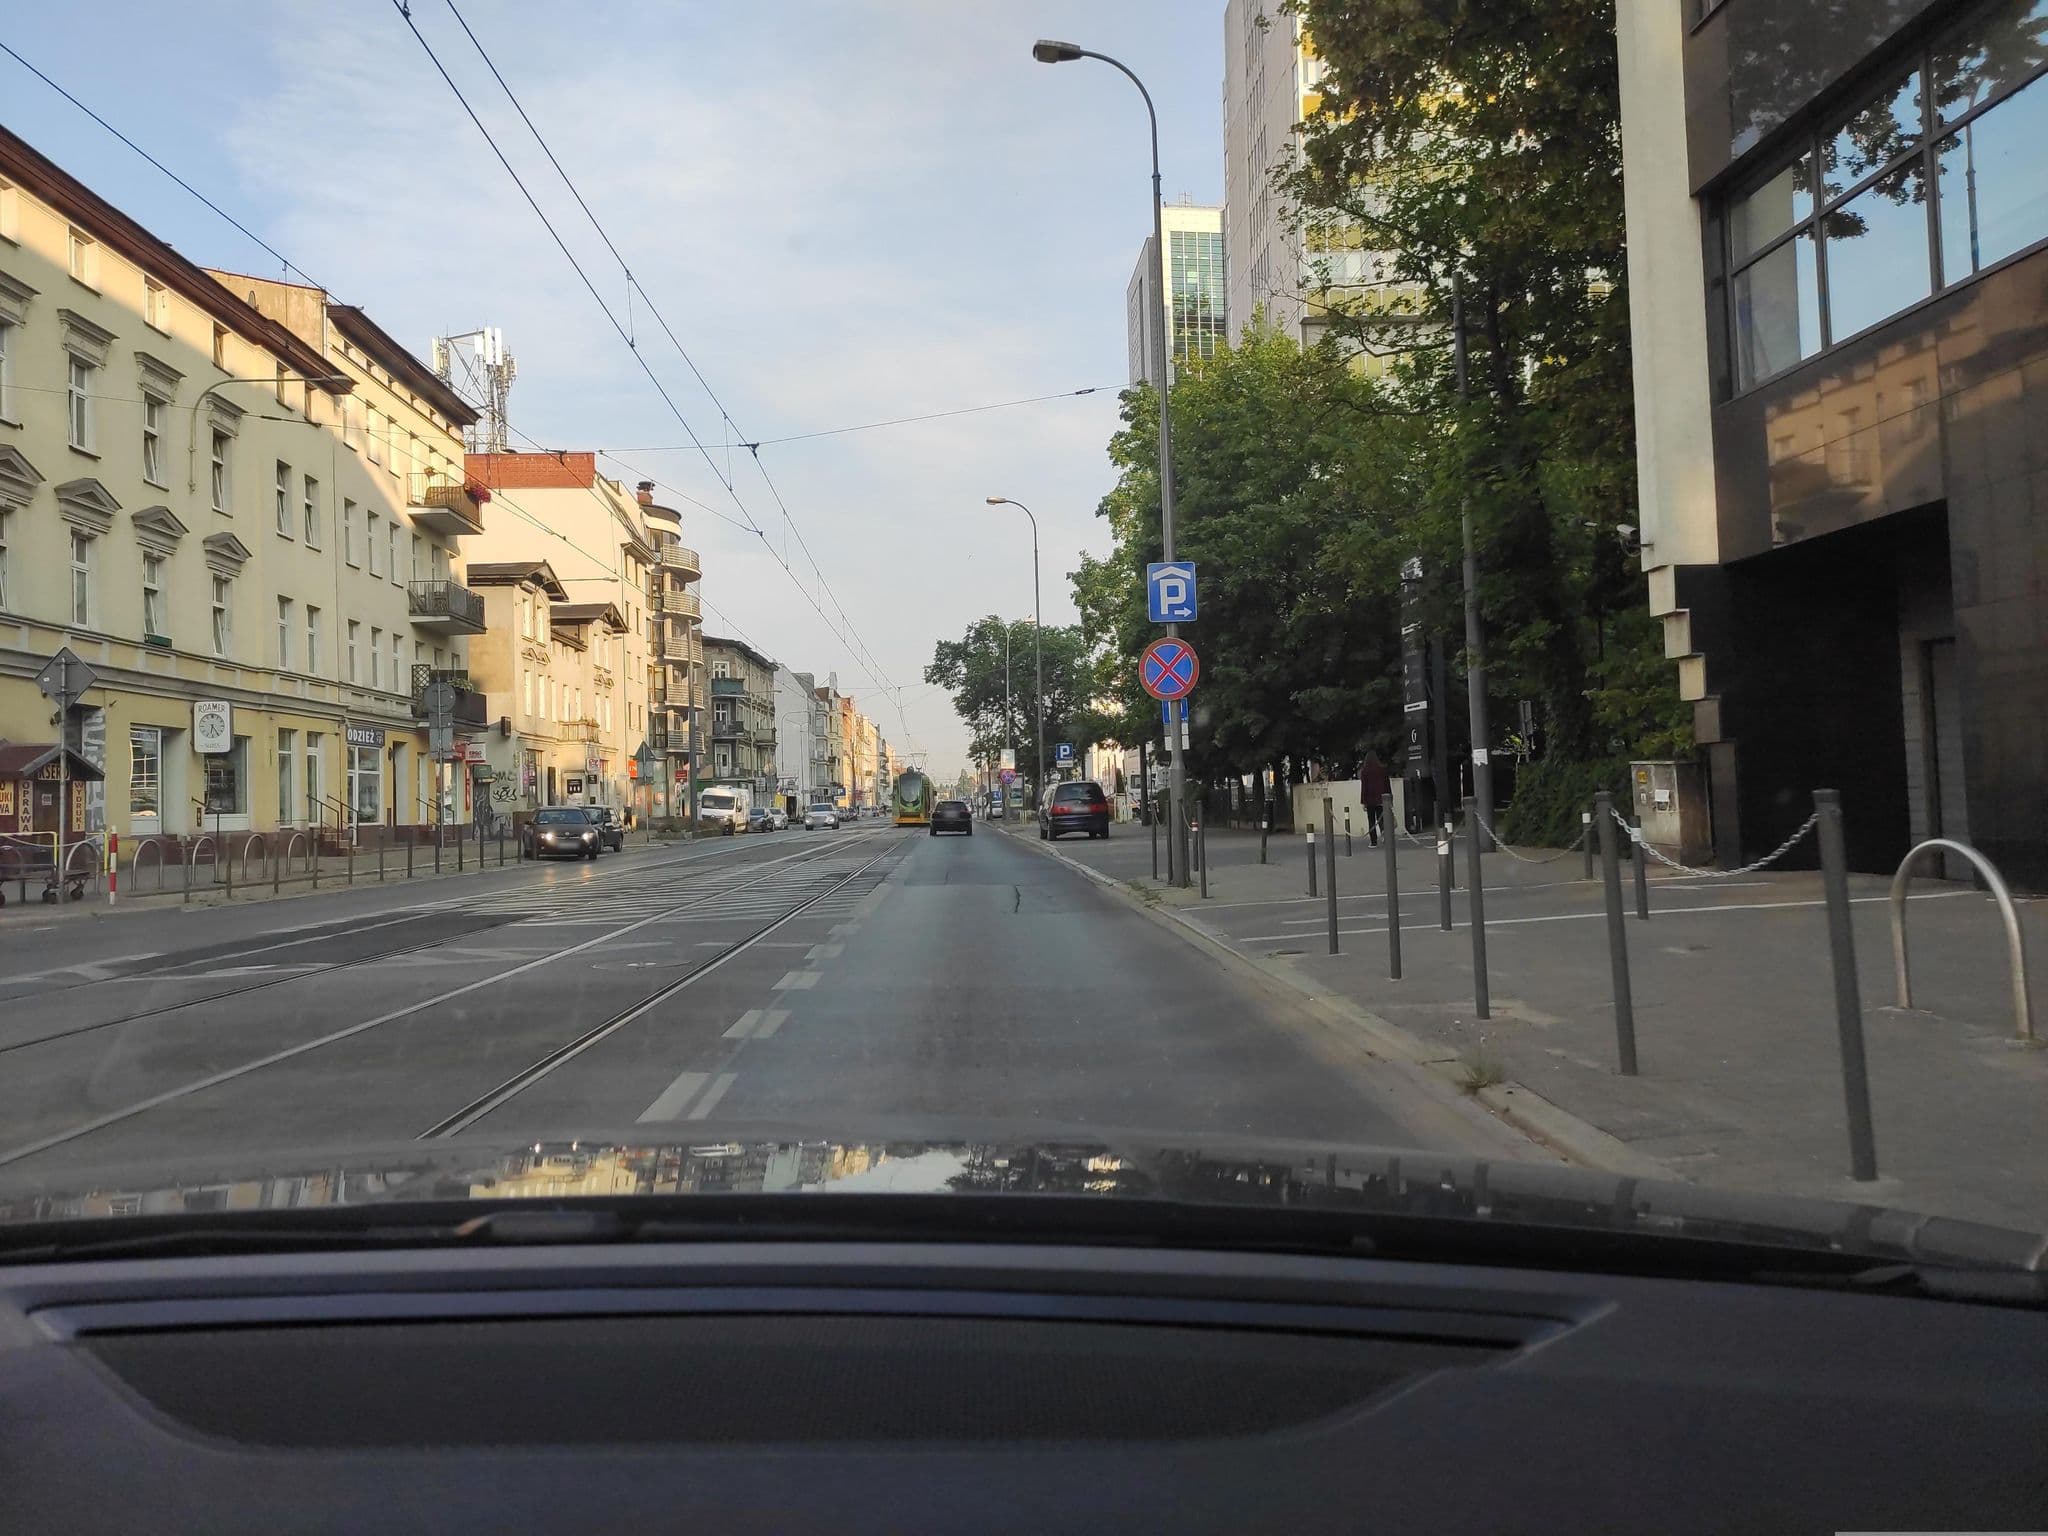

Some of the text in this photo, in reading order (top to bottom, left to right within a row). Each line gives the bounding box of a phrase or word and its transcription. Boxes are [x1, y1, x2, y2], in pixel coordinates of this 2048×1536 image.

[1159, 578, 1187, 615] P
[199, 703, 225, 713] ROAMER
[347, 729, 375, 744] ODZIEŻ
[1059, 745, 1070, 759] P
[20, 781, 32, 832] OPRAWA
[74, 781, 84, 830] WYDRUKI
